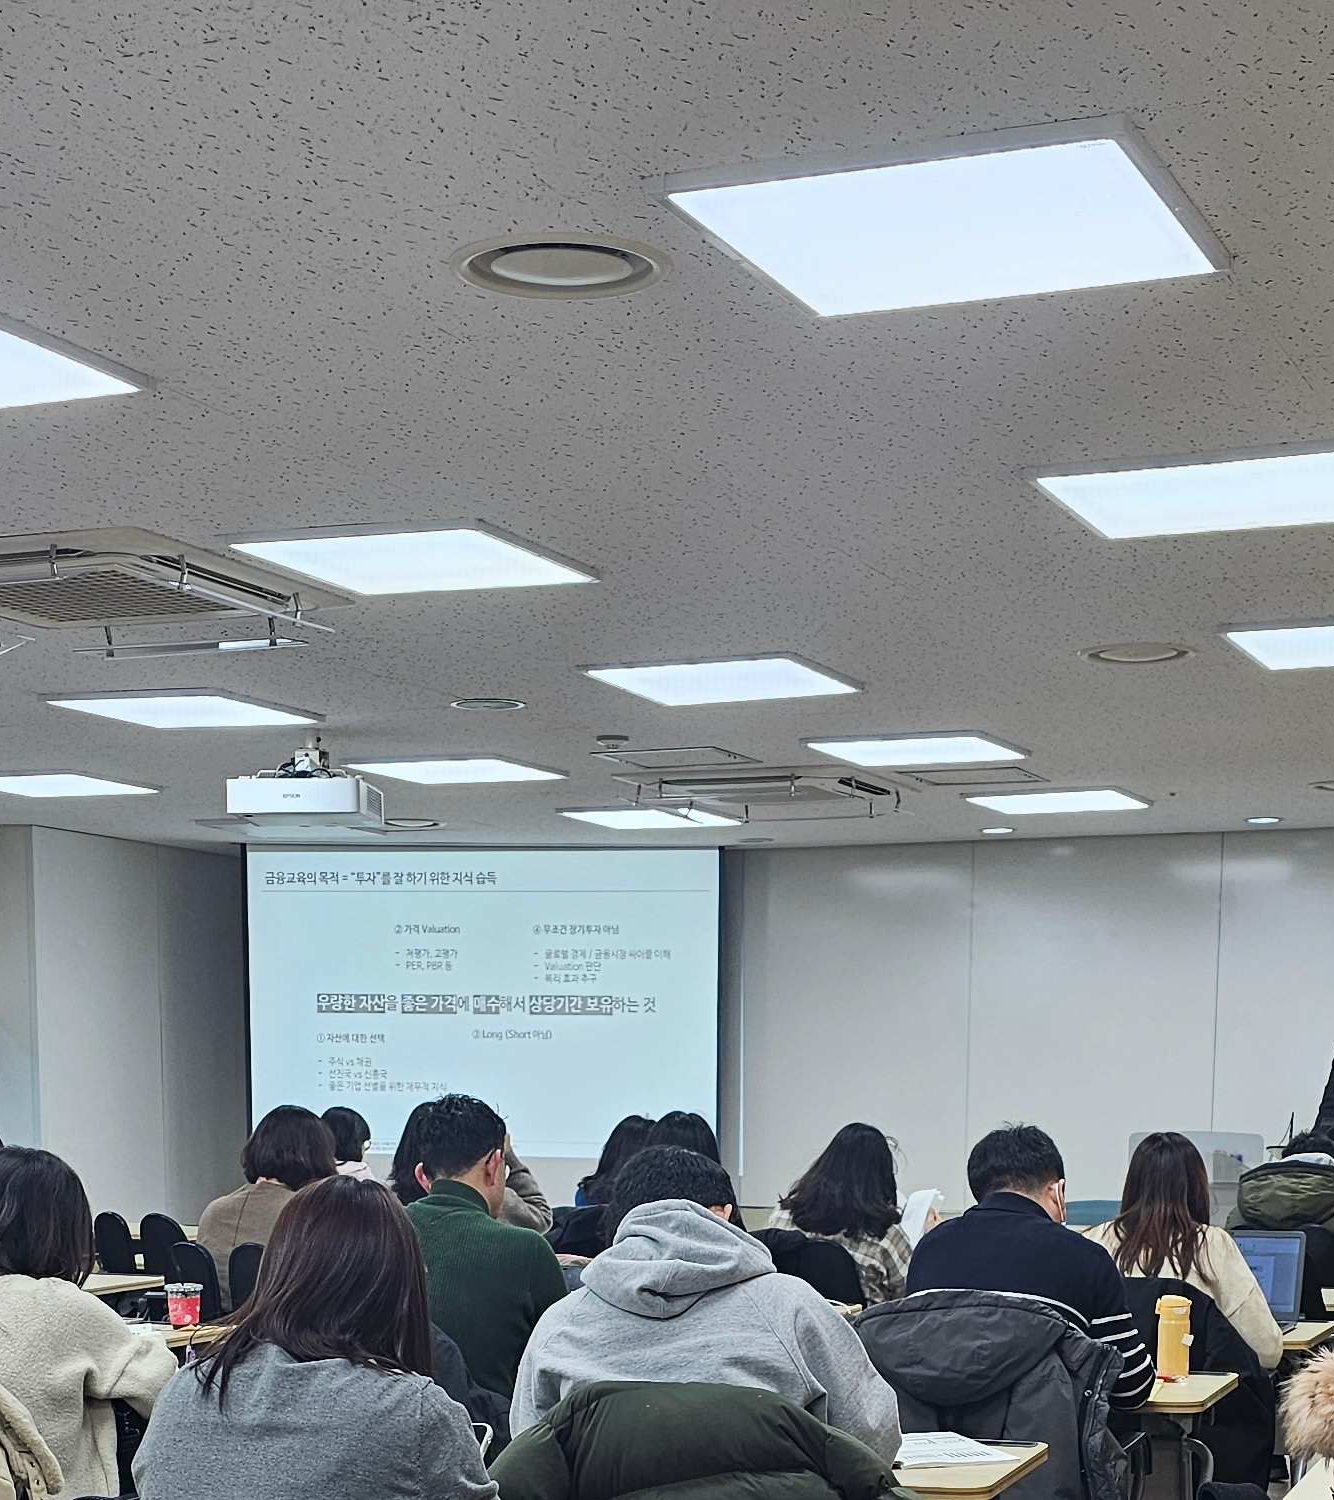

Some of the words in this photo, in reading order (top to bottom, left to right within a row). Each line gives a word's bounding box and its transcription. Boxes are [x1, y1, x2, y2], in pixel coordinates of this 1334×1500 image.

[265, 871, 317, 885] 금융교육의
[319, 871, 339, 885] 목적
[407, 871, 427, 885] 하기
[429, 871, 450, 885] 위한
[452, 871, 473, 885] 지식
[476, 871, 497, 885] 습득
[404, 924, 419, 934] 가격
[422, 924, 461, 934] Valuation
[543, 924, 567, 935] 무조건
[569, 924, 601, 935] 장기투자
[603, 924, 620, 935] 아님
[406, 949, 432, 959] 저평가,
[435, 949, 458, 959] 고평가
[427, 961, 443, 971] PBR
[545, 962, 583, 971] Valuation
[563, 974, 579, 984] 효과
[318, 995, 356, 1012] 우량한
[359, 995, 398, 1012] 자산을
[402, 995, 428, 1012] 좋은
[431, 995, 470, 1012] 가격에
[473, 995, 525, 1012] 매수해서
[530, 995, 583, 1012] 상당기간
[586, 995, 639, 1012] 보유하는
[352, 1033, 367, 1043] 대한
[369, 1033, 385, 1043] 선택
[482, 1030, 502, 1040] Long
[505, 1030, 531, 1040] (Short
[329, 1057, 344, 1067] 주식
